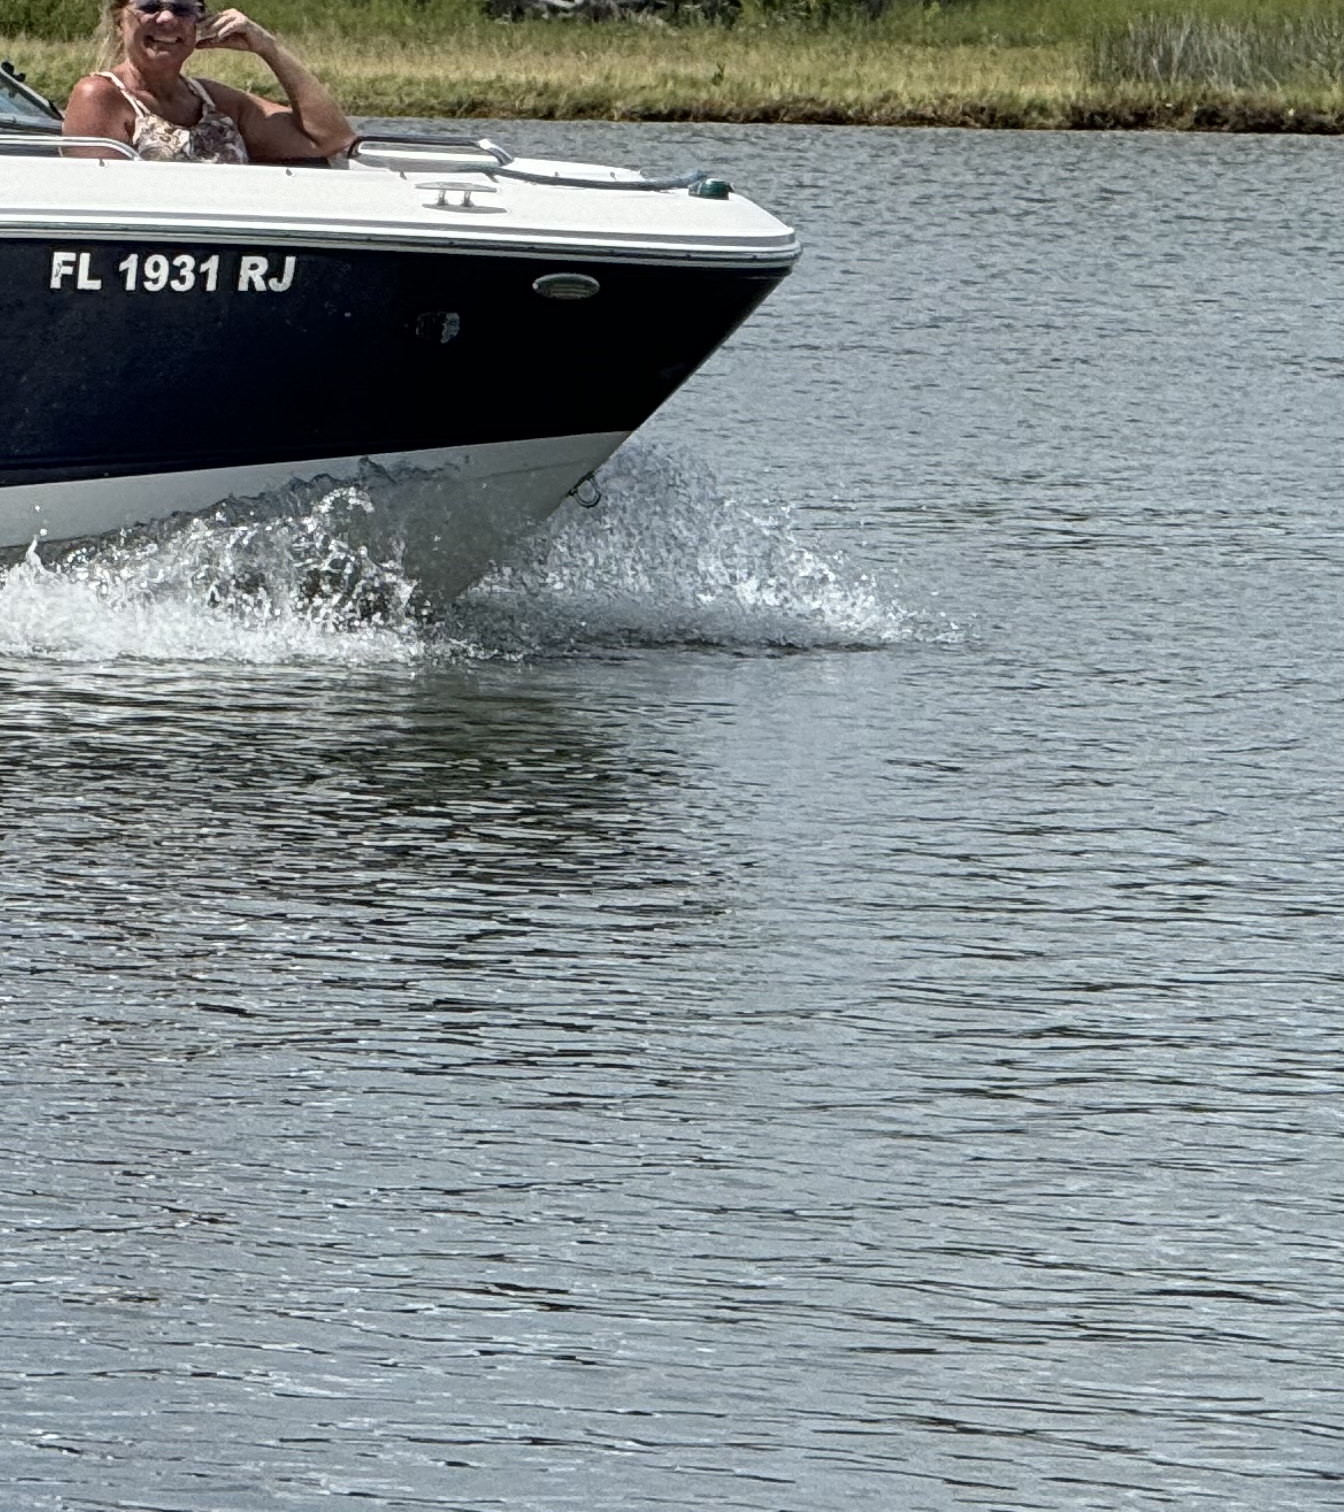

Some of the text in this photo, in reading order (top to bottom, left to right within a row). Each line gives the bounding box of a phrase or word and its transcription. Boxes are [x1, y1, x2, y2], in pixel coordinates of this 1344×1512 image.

[49, 251, 297, 293] FL 1931 RJ
